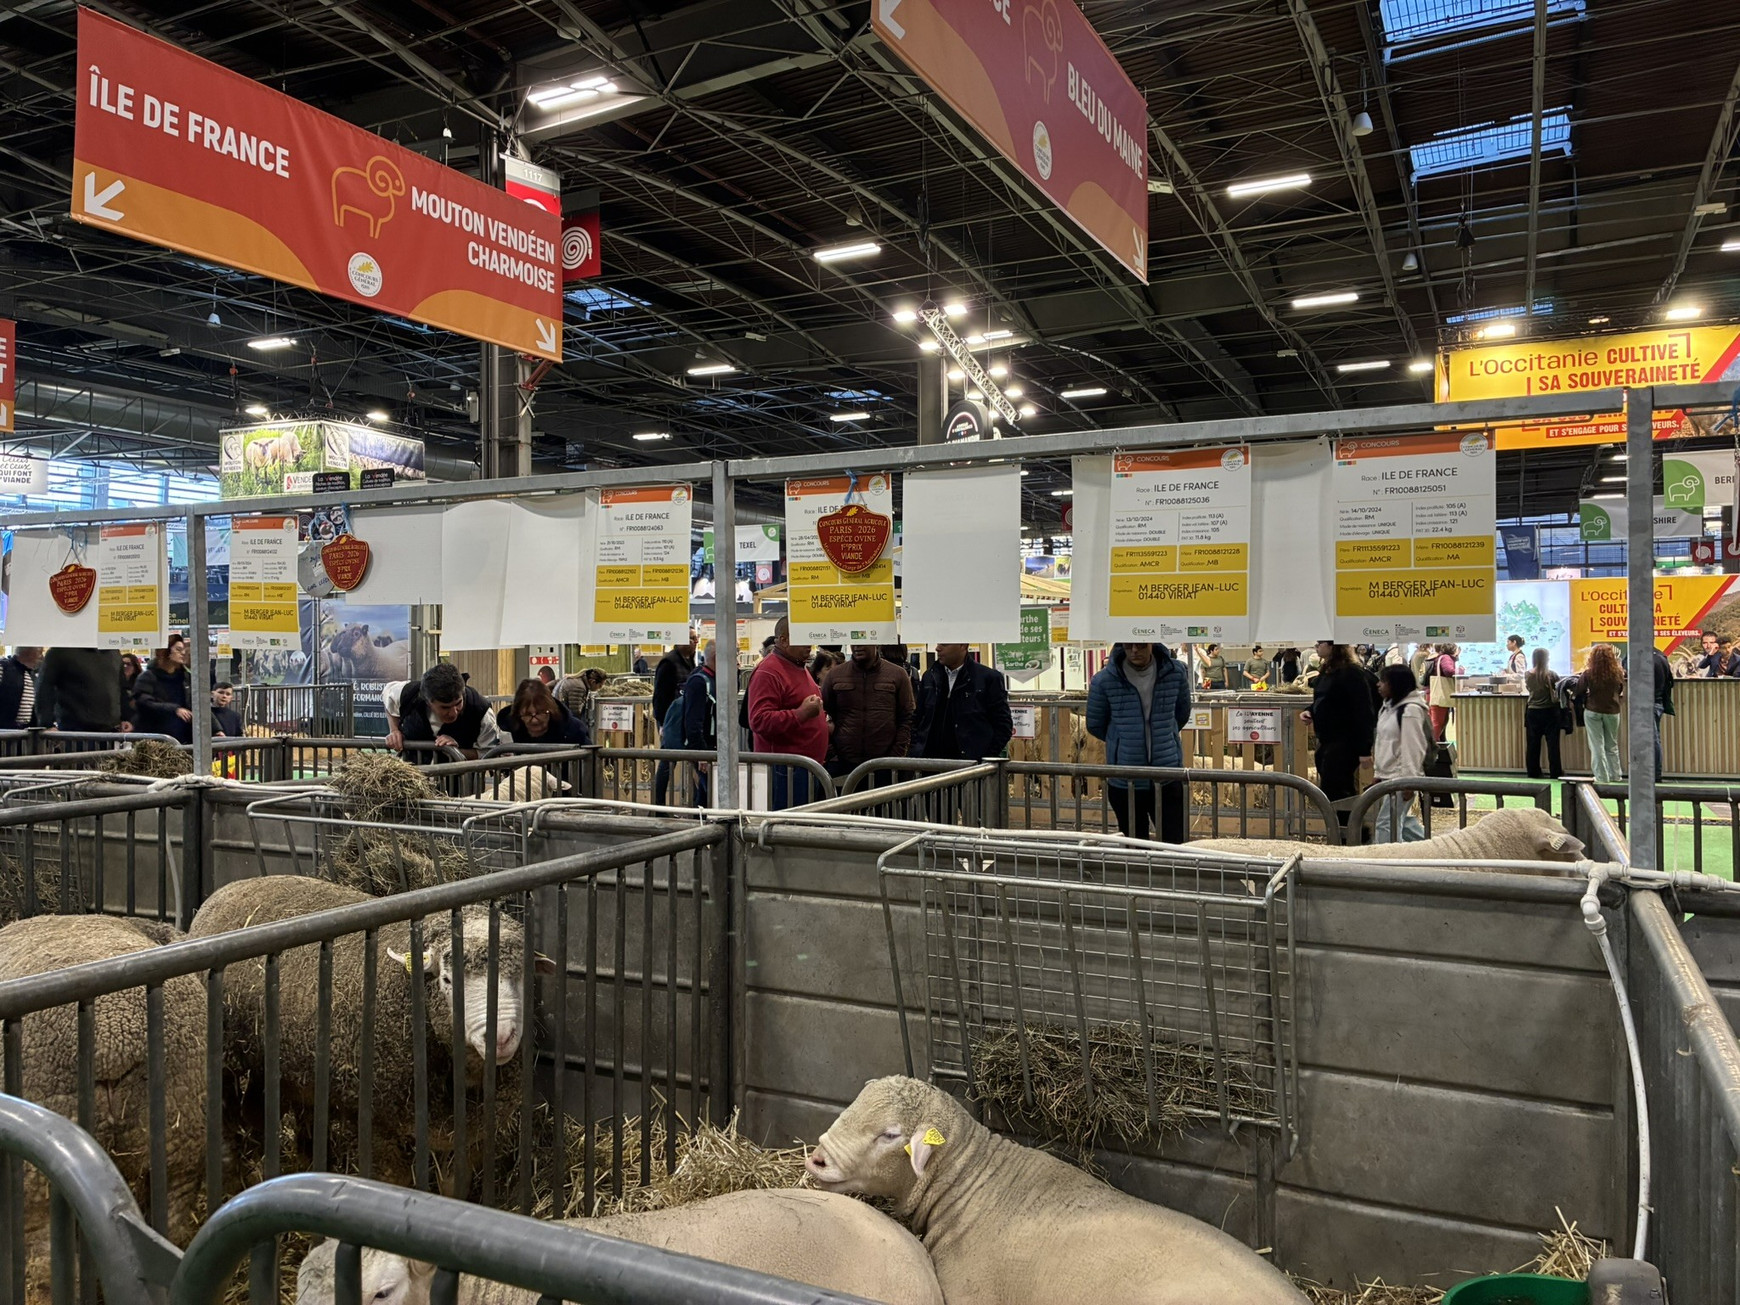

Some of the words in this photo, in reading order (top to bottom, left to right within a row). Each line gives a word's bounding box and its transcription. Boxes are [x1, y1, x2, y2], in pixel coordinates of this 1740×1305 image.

[89, 64, 134, 120] ÎLE
[143, 94, 179, 137] DE
[188, 111, 289, 178] FRANCE
[1068, 61, 1095, 124] BLEU
[1098, 98, 1111, 143] DU
[1114, 117, 1142, 180] MAINE
[523, 169, 542, 182] 1117
[412, 186, 484, 237] MOUTON
[488, 218, 555, 264] VENDÉEN
[468, 241, 555, 294] CHARMOISE
[1470, 349, 1598, 377] L'Occitanie
[1607, 343, 1678, 364] CULTIVE
[1538, 375, 1561, 392] SA
[1568, 357, 1700, 388] SOUVERAINETÉ
[1550, 428, 1559, 437] ET
[1561, 426, 1596, 436] S'ENGAGE
[1599, 424, 1617, 434] POUR
[1652, 420, 1680, 430] VEURS.
[1382, 472, 1396, 480] ILE
[1399, 470, 1413, 479] DE
[1416, 468, 1458, 478] FRANCE
[1154, 484, 1166, 492] ILE
[1169, 484, 1180, 492] DE
[1183, 481, 1219, 490] FRANCE
[1385, 485, 1446, 494] FR10088125051
[1155, 497, 1210, 505] FR10088125036
[1653, 516, 1676, 524] SHIRE
[1151, 584, 1189, 593] BERGER
[1190, 583, 1239, 594] JEAN-LUC
[1368, 582, 1380, 590] M
[1383, 580, 1427, 590] BERGER
[1428, 578, 1485, 592] JEAN-LUC
[851, 593, 887, 603] JEAN-LUC
[1138, 592, 1166, 600] 01440
[1168, 591, 1198, 599] VIRIAT
[1368, 589, 1400, 598] 01440
[1402, 588, 1437, 598] VIRIAT
[1581, 589, 1663, 602] L'Occite
[650, 596, 682, 604] JEAN-LUC
[1021, 615, 1038, 623] rthe
